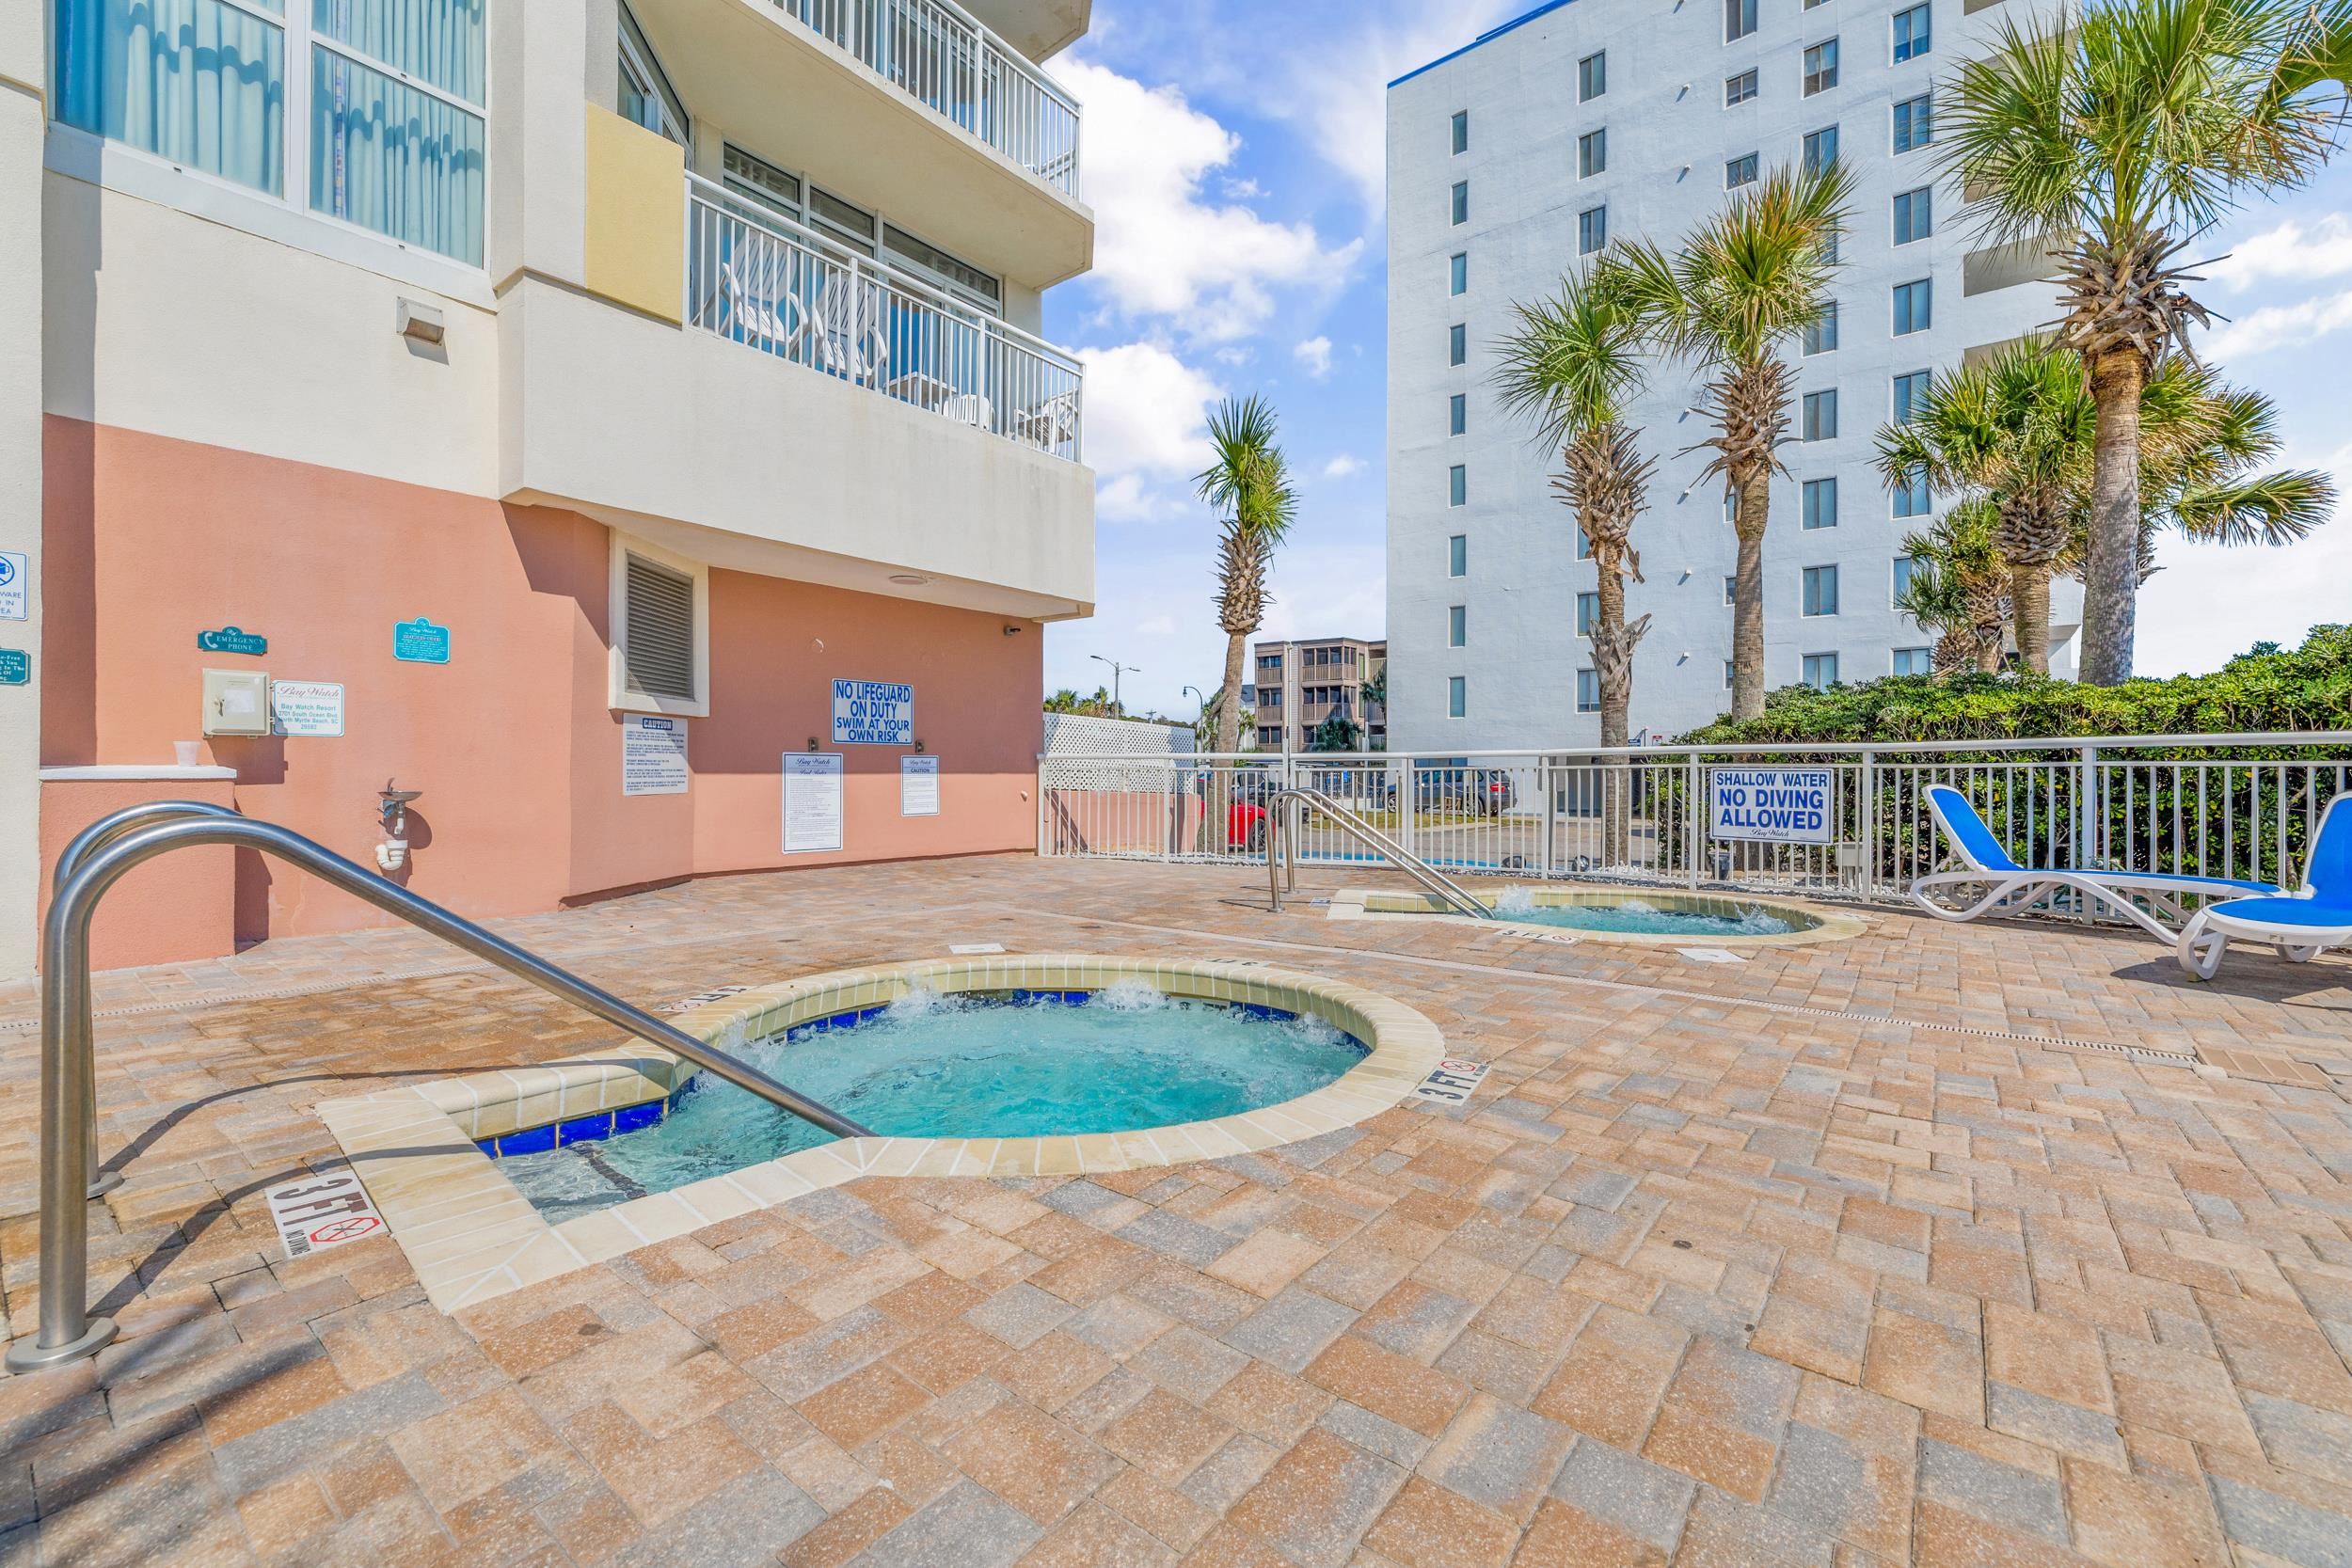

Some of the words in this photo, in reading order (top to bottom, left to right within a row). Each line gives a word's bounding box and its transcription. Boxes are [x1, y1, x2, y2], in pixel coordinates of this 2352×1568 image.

[216, 636, 263, 645] EMERGENCY
[278, 686, 307, 697] Bay
[307, 687, 340, 697] Watch
[835, 682, 853, 699] NO
[857, 684, 911, 703] LIFEGUARD
[850, 701, 866, 718] ON
[870, 702, 898, 719] DUTY
[644, 720, 672, 729] CAUTION
[836, 717, 865, 729] SWIM
[868, 719, 880, 730] AT
[883, 720, 910, 731] YOUR
[848, 730, 874, 740] OWN
[878, 731, 898, 742] RISK
[1716, 772, 1776, 786] SHALLOW
[1782, 773, 1828, 787] WATER
[1719, 788, 1746, 806] NO
[1756, 789, 1823, 810] DIVING
[1720, 808, 1822, 830] ALLOWED
[1750, 829, 1767, 837] Bay
[1768, 829, 1789, 837] Watch
[1425, 1069, 1478, 1090] FT
[278, 1191, 370, 1227] FT
